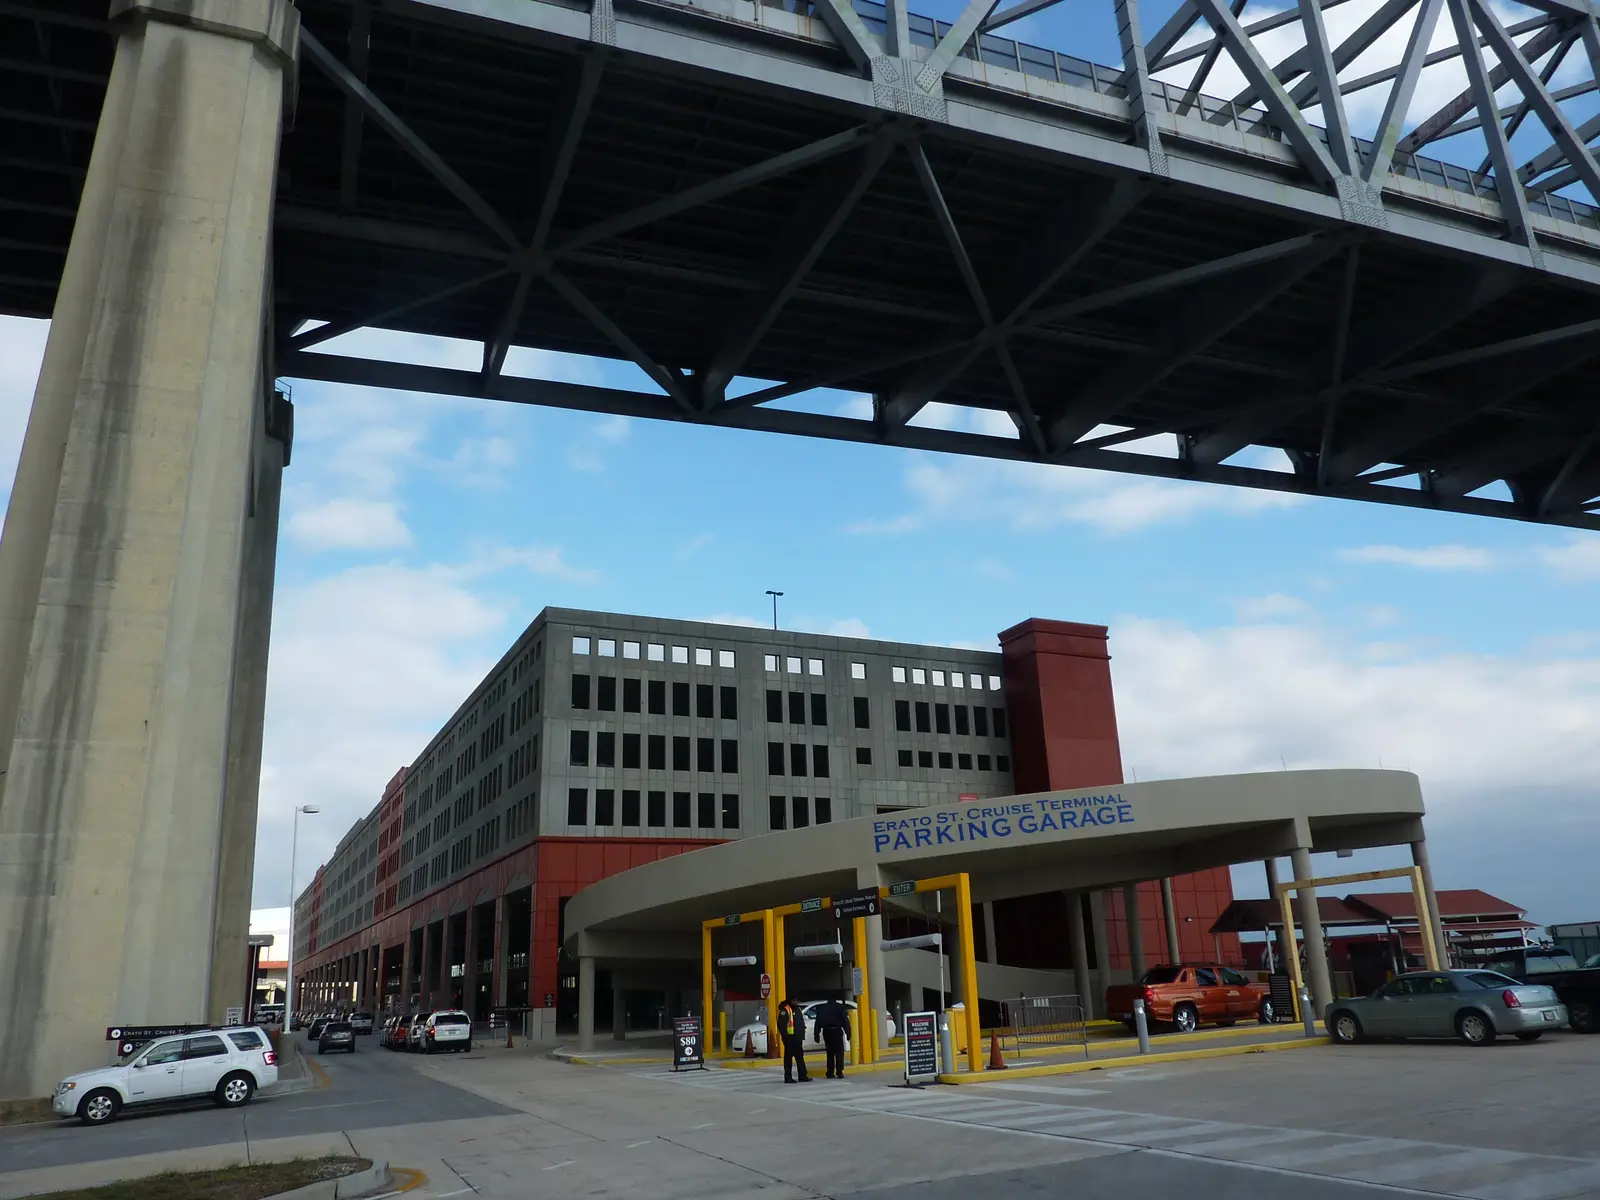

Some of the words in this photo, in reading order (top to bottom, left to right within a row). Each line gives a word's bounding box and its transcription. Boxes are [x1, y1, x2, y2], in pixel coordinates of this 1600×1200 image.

[873, 816, 932, 833] ERATO
[936, 812, 964, 824] ST.
[967, 803, 1034, 820] CRUISE
[1036, 793, 1128, 812] TERMINAL
[874, 818, 1012, 853] PARKING
[1018, 804, 1135, 834] GARAGE
[893, 883, 911, 894] ENTER
[228, 1017, 239, 1025] 15
[680, 1036, 696, 1046] $80
